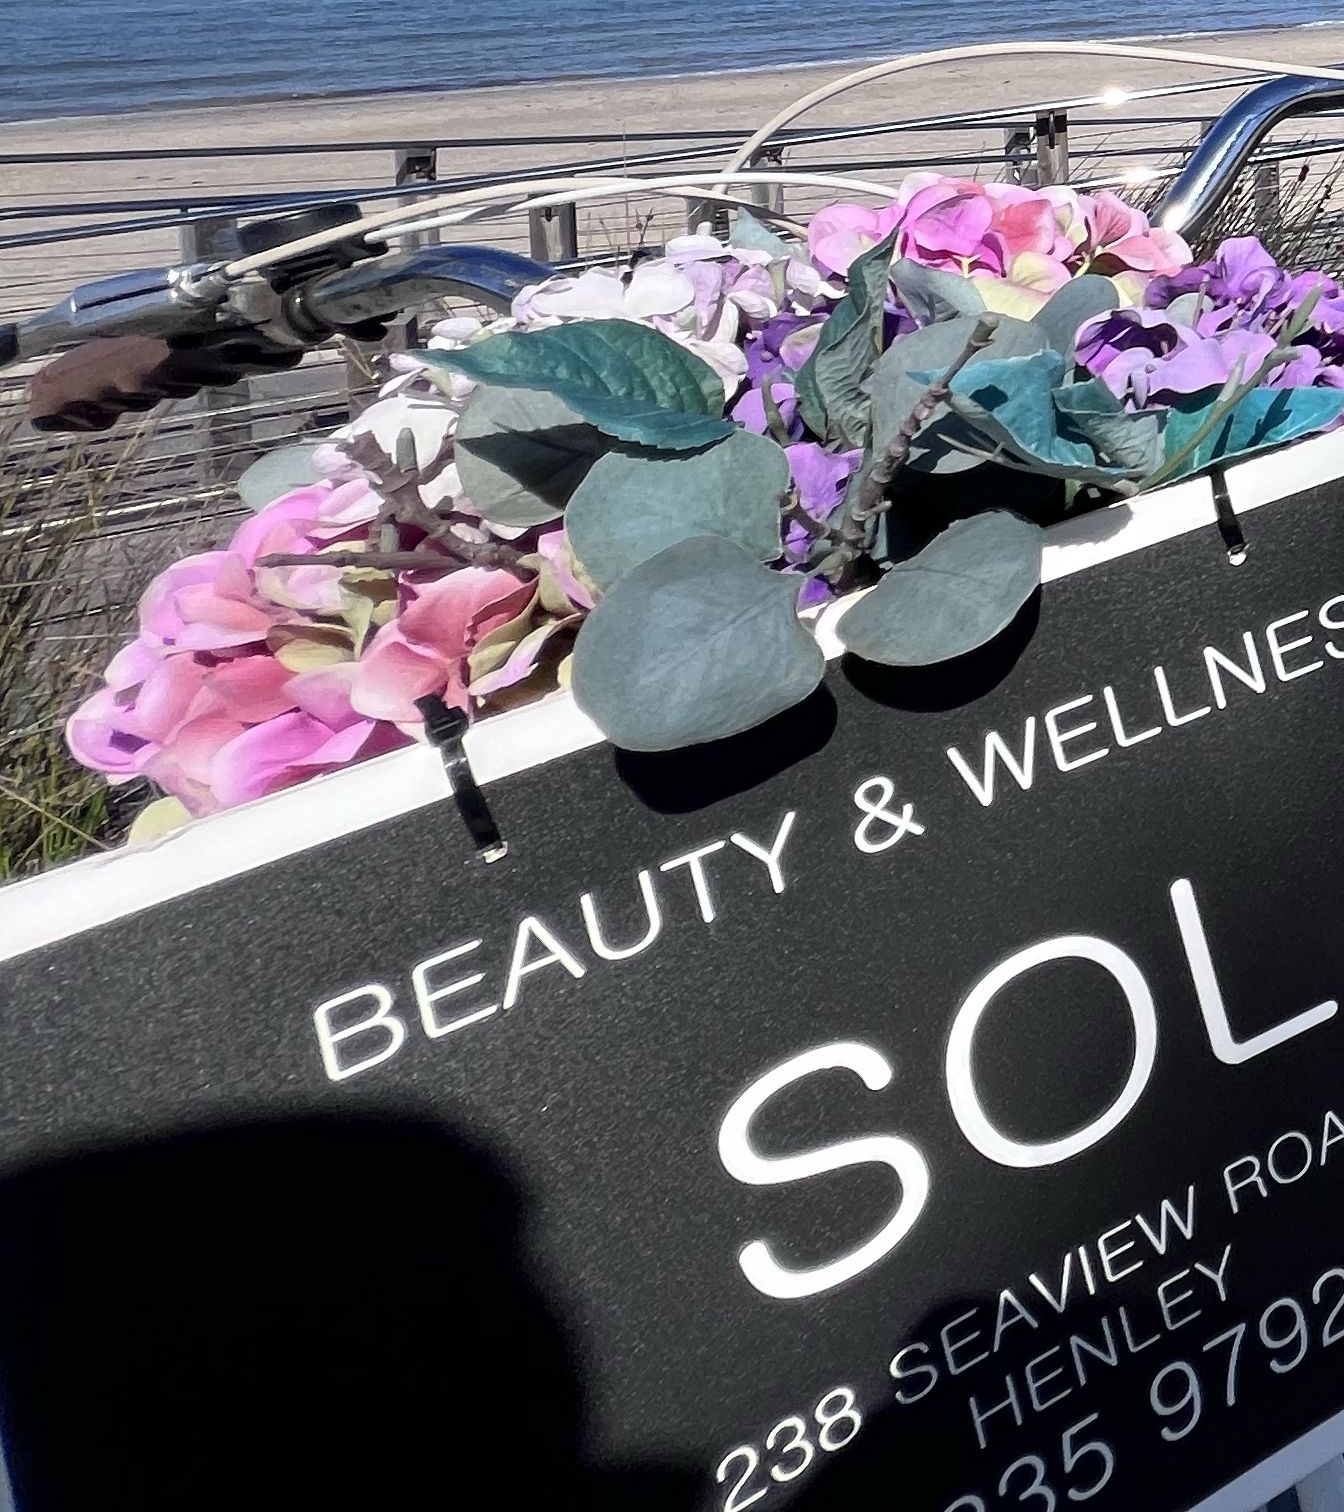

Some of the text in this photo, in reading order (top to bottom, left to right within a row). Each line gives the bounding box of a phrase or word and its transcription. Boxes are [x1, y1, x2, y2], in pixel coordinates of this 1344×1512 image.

[312, 810, 796, 1083] BEAUTY
[852, 775, 926, 854] &
[717, 878, 1339, 1299] SOL
[715, 1386, 864, 1512] 238
[888, 1184, 1197, 1405] SEAVIEW
[943, 1412, 1115, 1512] 35
[968, 1244, 1233, 1450] HENLEY
